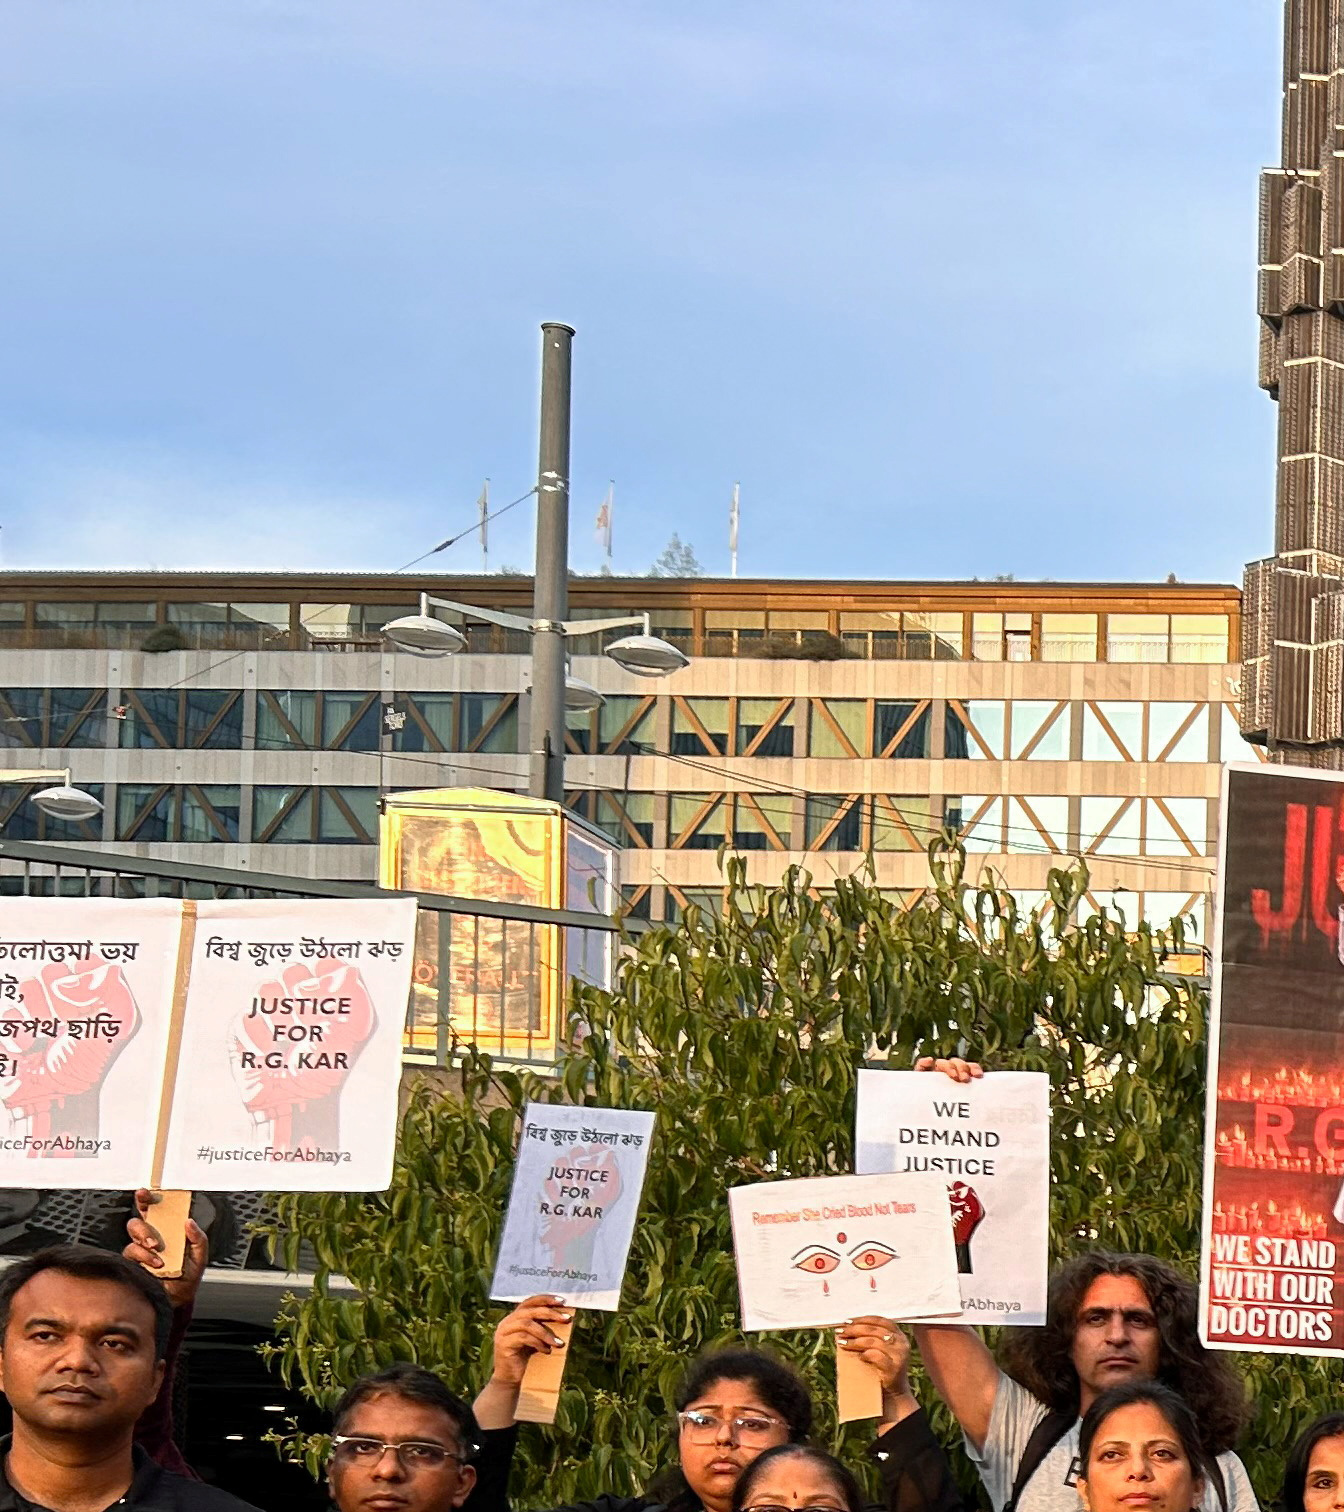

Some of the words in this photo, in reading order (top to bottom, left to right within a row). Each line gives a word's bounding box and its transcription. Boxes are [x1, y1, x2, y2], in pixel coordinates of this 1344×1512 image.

[101, 941, 139, 964] ভয়
[205, 937, 242, 961] বিশ্ব
[248, 941, 292, 967] জুড়ে
[300, 937, 361, 960] উঠলো
[368, 942, 404, 963] ঝড়
[248, 997, 351, 1018] JUSTICE
[68, 1012, 121, 1044] ছাড়ি
[272, 1025, 323, 1043] FOR
[241, 1051, 288, 1070] R.G.
[297, 1052, 349, 1070] KAR
[933, 1101, 970, 1118] WE
[526, 1123, 548, 1141] বিশ্ব
[550, 1129, 578, 1147] জুড়ে
[581, 1126, 618, 1146] উঠলো
[898, 1129, 1001, 1148] DEMAND
[196, 1145, 351, 1165] #justiceForAbhaya
[547, 1167, 609, 1183] JUSTICE
[903, 1157, 995, 1177] JUSTICE
[560, 1186, 590, 1200] FOR
[540, 1203, 568, 1217] R.G.
[572, 1204, 603, 1219] KAR
[1213, 1234, 1252, 1264] WE
[1255, 1237, 1336, 1270] STAND
[508, 1264, 598, 1283] #justiceForAbhaya
[1212, 1268, 1275, 1300] WITH
[1280, 1272, 1334, 1305] OUR
[1210, 1306, 1333, 1341] DOCTORS
